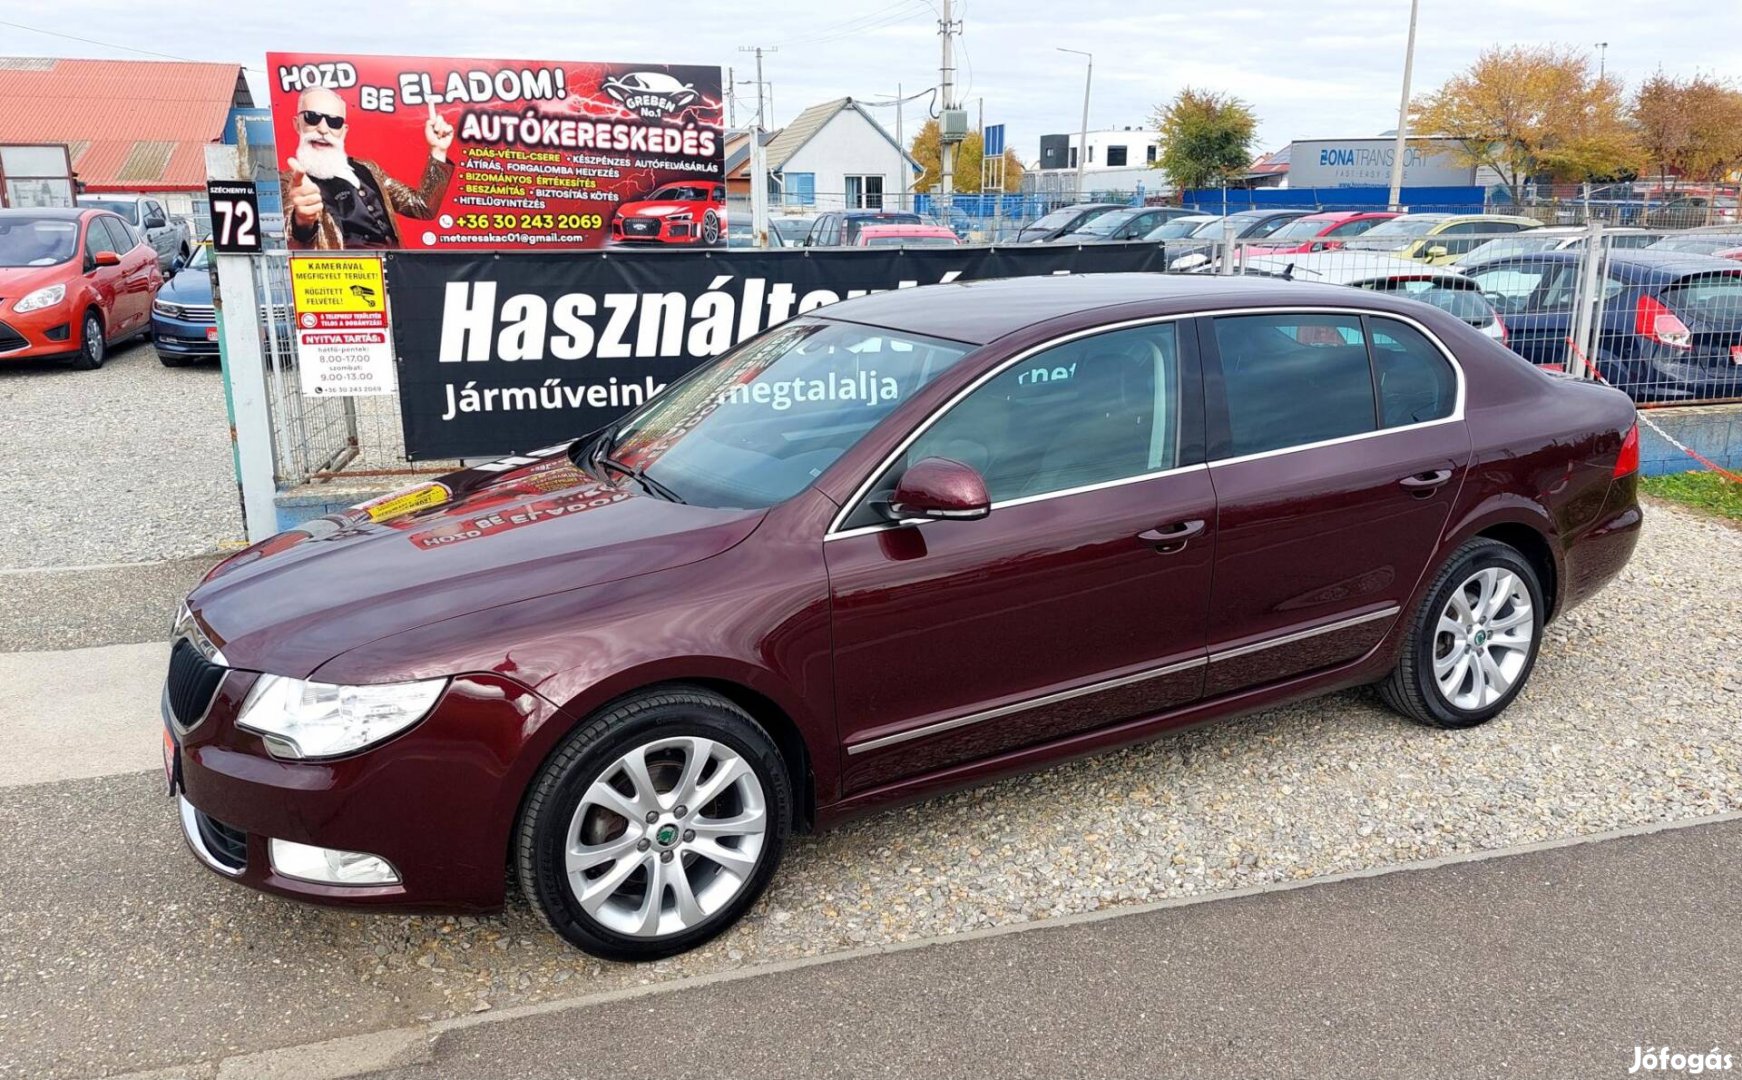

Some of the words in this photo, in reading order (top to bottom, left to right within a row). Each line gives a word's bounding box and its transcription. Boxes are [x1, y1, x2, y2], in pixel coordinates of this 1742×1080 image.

[280, 63, 357, 92] HOZD
[360, 86, 395, 112] BE
[400, 69, 568, 104] ELADOM!
[626, 95, 676, 113] GREBEN
[640, 107, 662, 117] No.1
[460, 110, 716, 157] AUTÓKERESKEDÉS
[468, 148, 561, 163] ADÁS-VÉTEL-CSERE
[572, 154, 631, 167] KÉSZPÉNZES
[634, 158, 719, 173] AUTÓFELVÁSÁRLÁS
[1320, 148, 1427, 167] BONATRANSORT
[466, 159, 504, 172] ÁTÍRÁS,
[506, 163, 574, 175] FORGALOMBA
[575, 166, 620, 178] HELYEZÉS
[465, 172, 533, 184] BIZOMÁNYOS
[536, 174, 597, 188] ÉRTÉKESÍTÉS
[210, 186, 247, 195] SZÉCHENYI
[465, 184, 526, 196] BESZÁMÍTÁS
[535, 188, 589, 200] BIZTOSÍTÁS
[590, 191, 620, 202] KÖTÉS
[459, 196, 546, 209] HITELÜGYINTÉZÉS
[213, 200, 257, 246] 72
[457, 214, 490, 229] +36
[493, 214, 517, 229] 30
[520, 214, 554, 229] 243
[557, 214, 603, 229] 2069
[308, 262, 364, 271] KAMERÁVAL
[296, 272, 341, 280] MEGFIGYELT
[344, 272, 378, 280] TERÜLET!
[304, 287, 343, 296] RÖGZÍTETT
[306, 297, 344, 305] FELVÉTEL!
[306, 335, 343, 344] NYITVA
[343, 333, 382, 343] TARTÁS:
[319, 355, 371, 363] 8.00-17.00
[320, 373, 373, 381] 9.00-13.00
